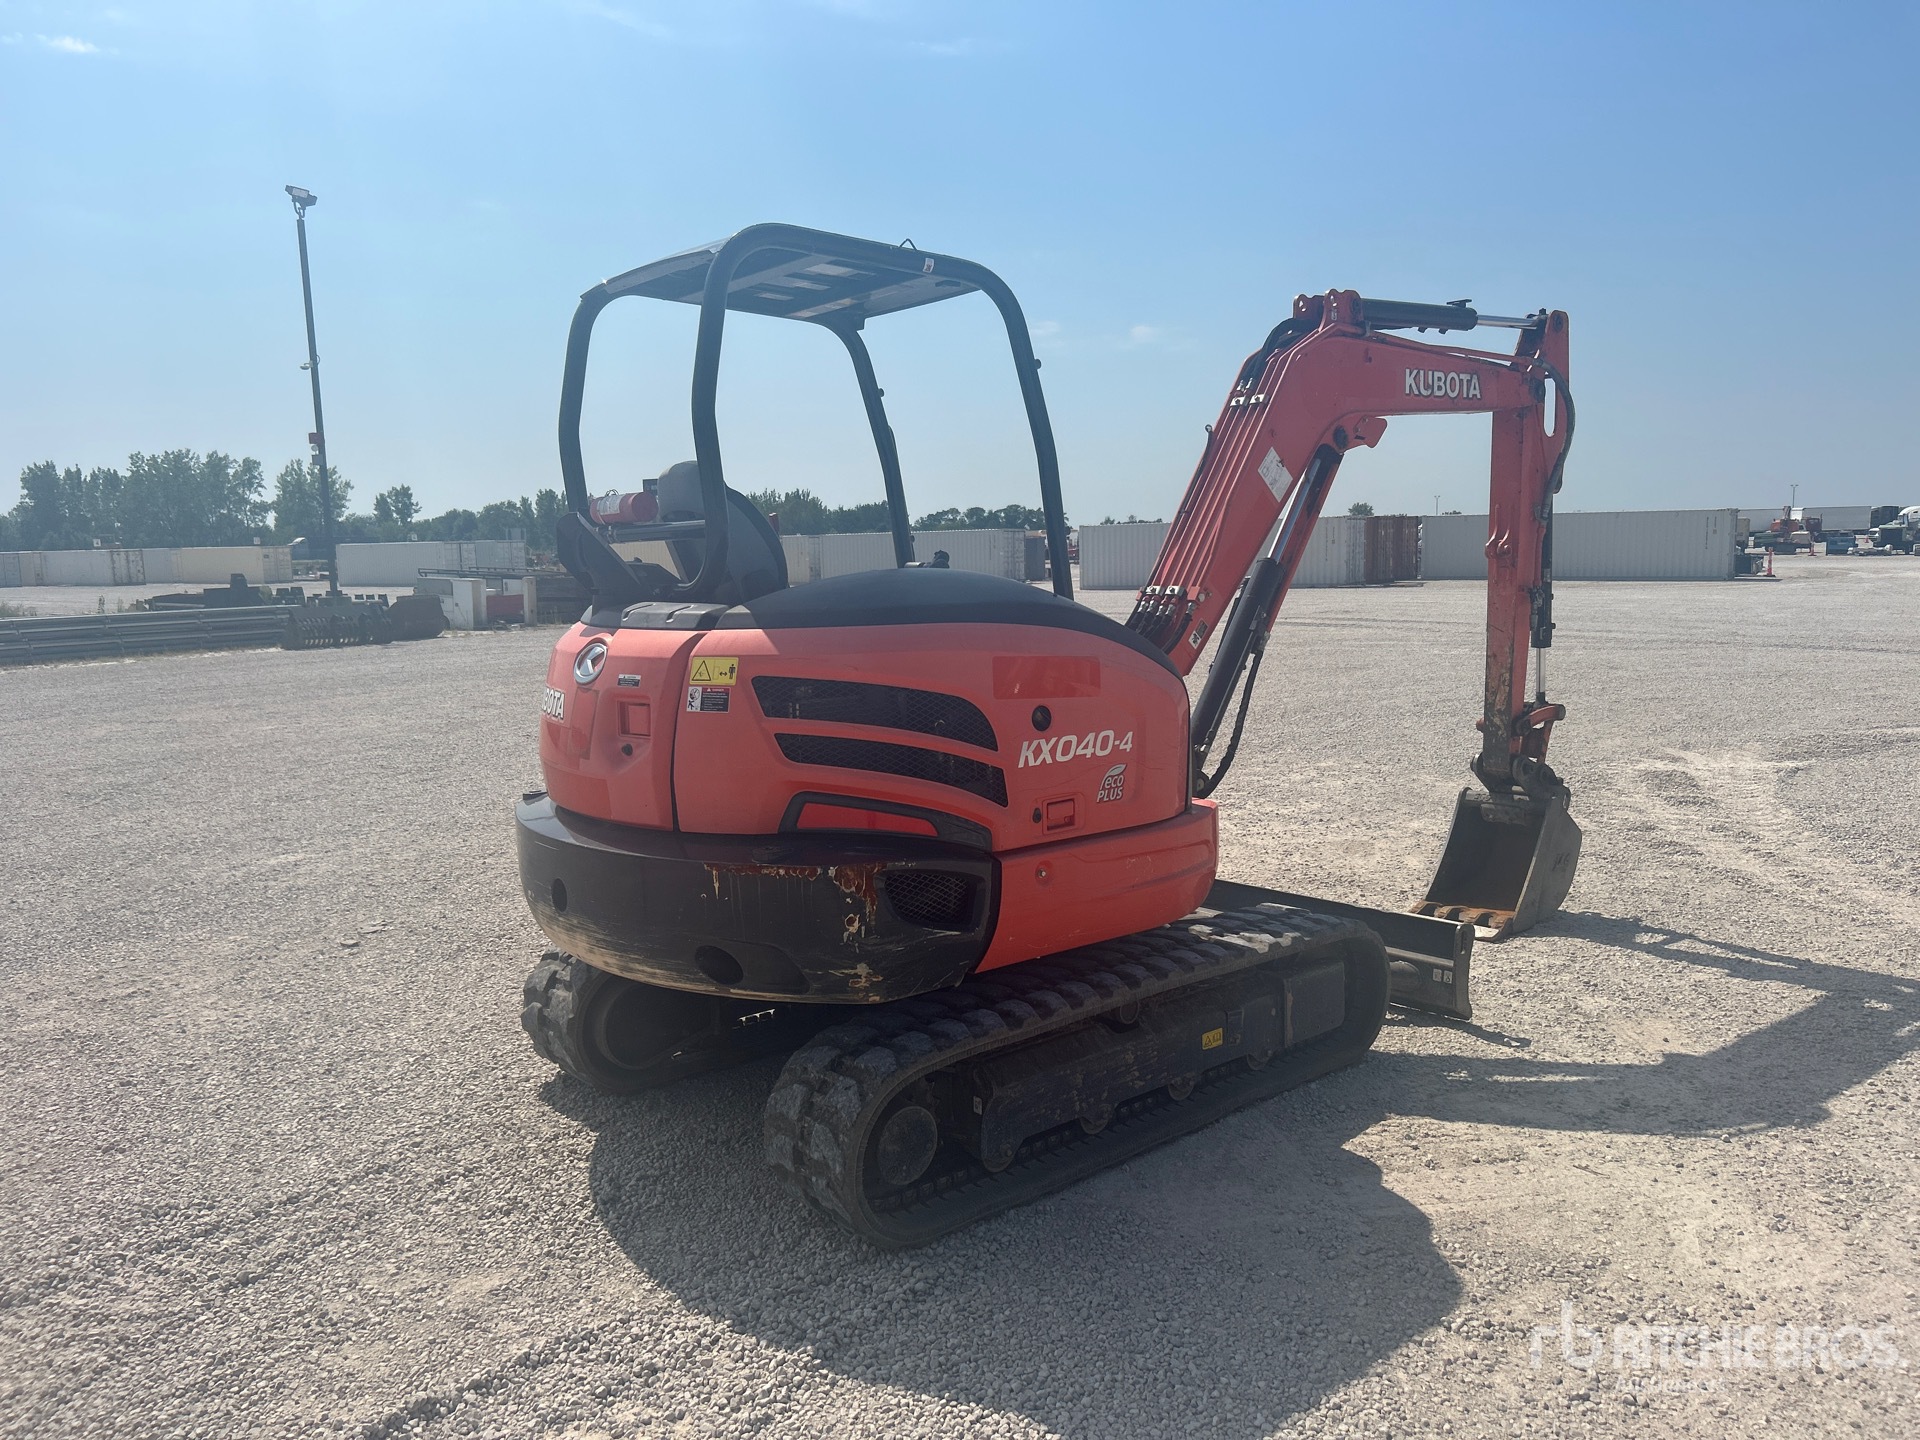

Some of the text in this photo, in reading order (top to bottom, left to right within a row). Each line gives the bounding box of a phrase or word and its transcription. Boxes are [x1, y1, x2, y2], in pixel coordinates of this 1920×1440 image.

[1405, 367, 1481, 399] KUBOTA
[1017, 730, 1134, 769] KX040-4
[1096, 787, 1123, 803] PLUS
